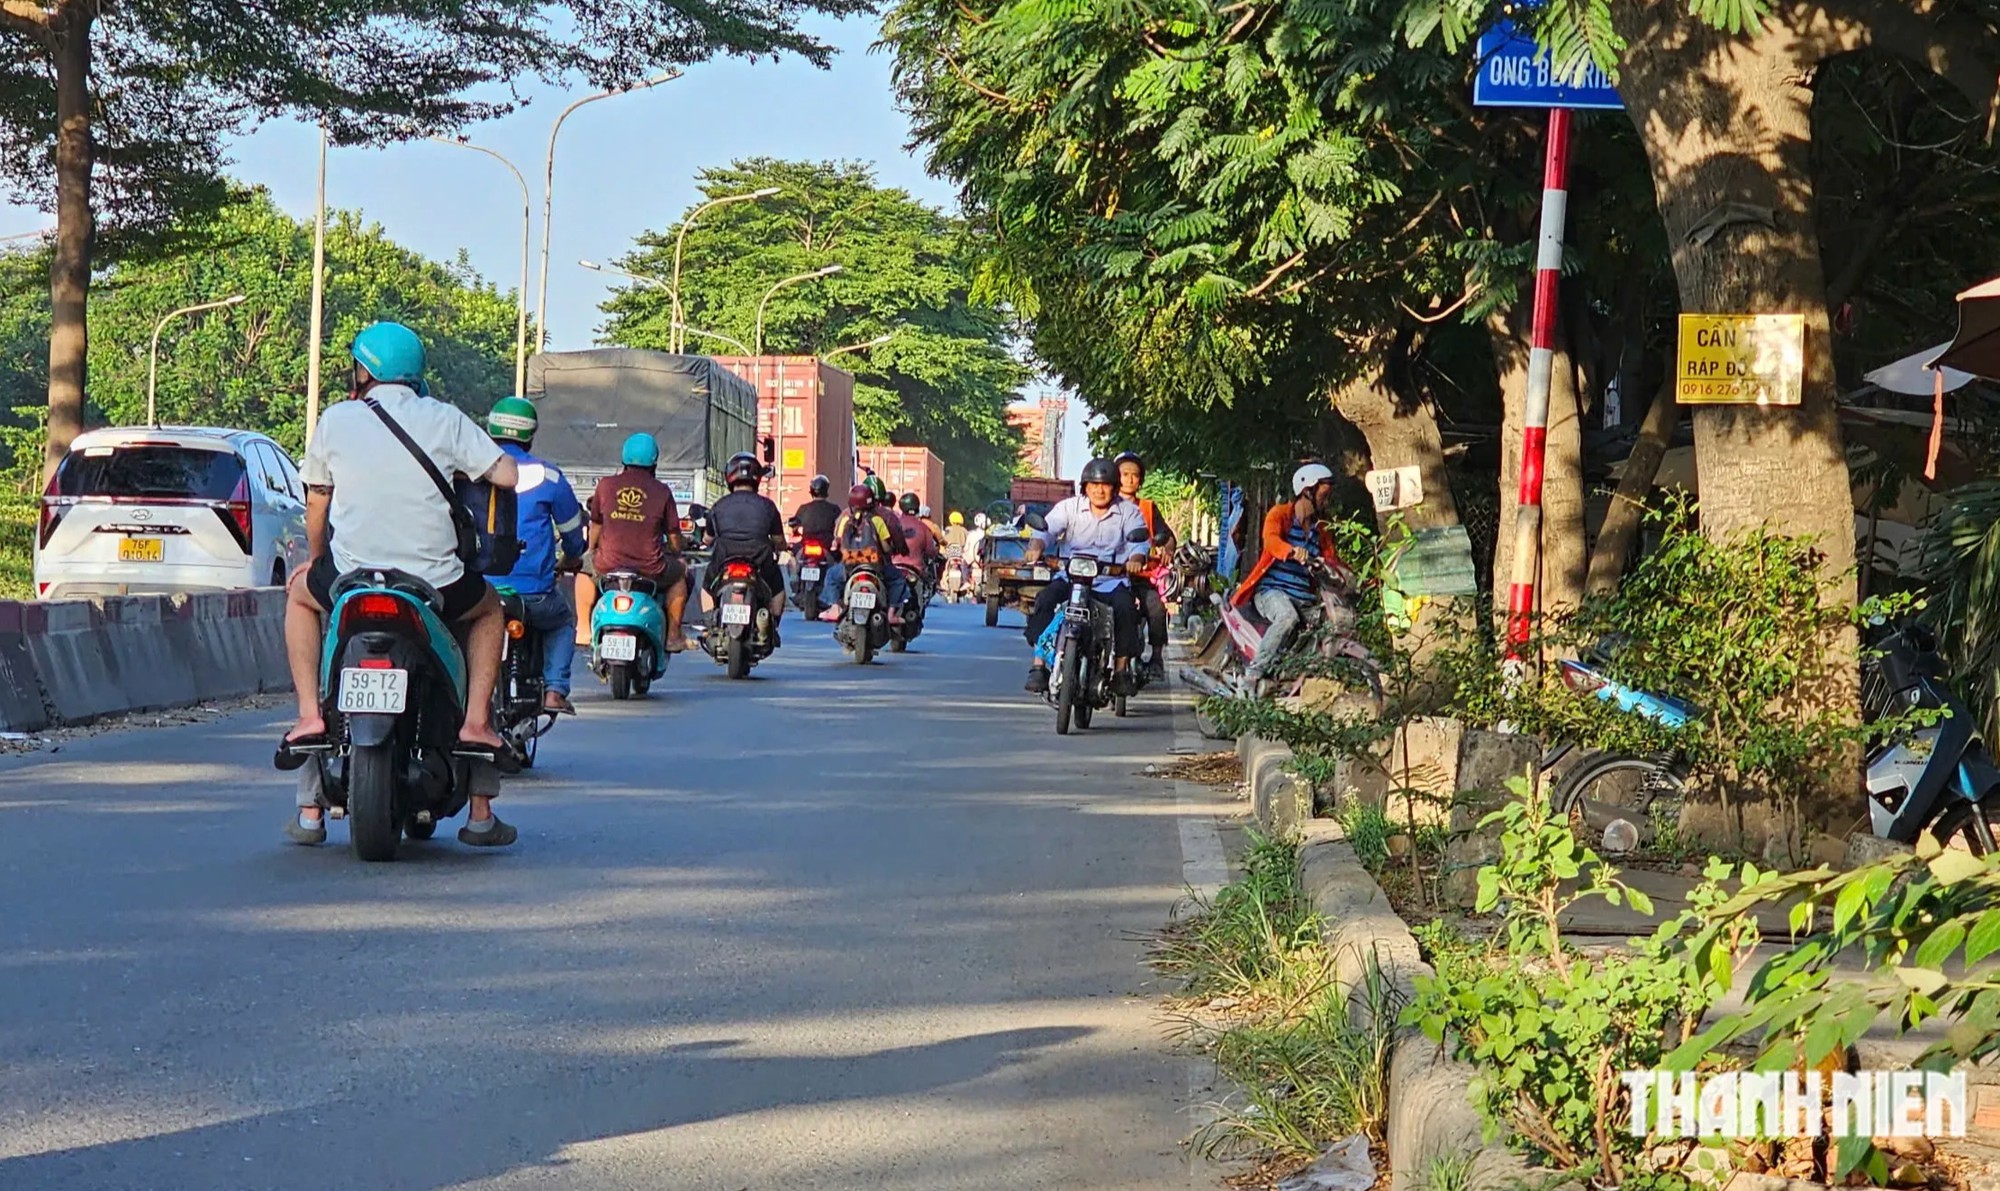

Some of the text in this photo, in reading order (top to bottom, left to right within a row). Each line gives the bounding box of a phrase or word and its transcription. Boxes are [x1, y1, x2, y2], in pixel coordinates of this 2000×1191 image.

[1489, 55, 1531, 87] ONG
[1697, 320, 1736, 348] CẦN
[1687, 356, 1719, 377] RÁP
[1682, 384, 1713, 395] 0916
[132, 540, 150, 550] 76F
[351, 672, 397, 690] 59-T2
[345, 691, 399, 709] 680.12
